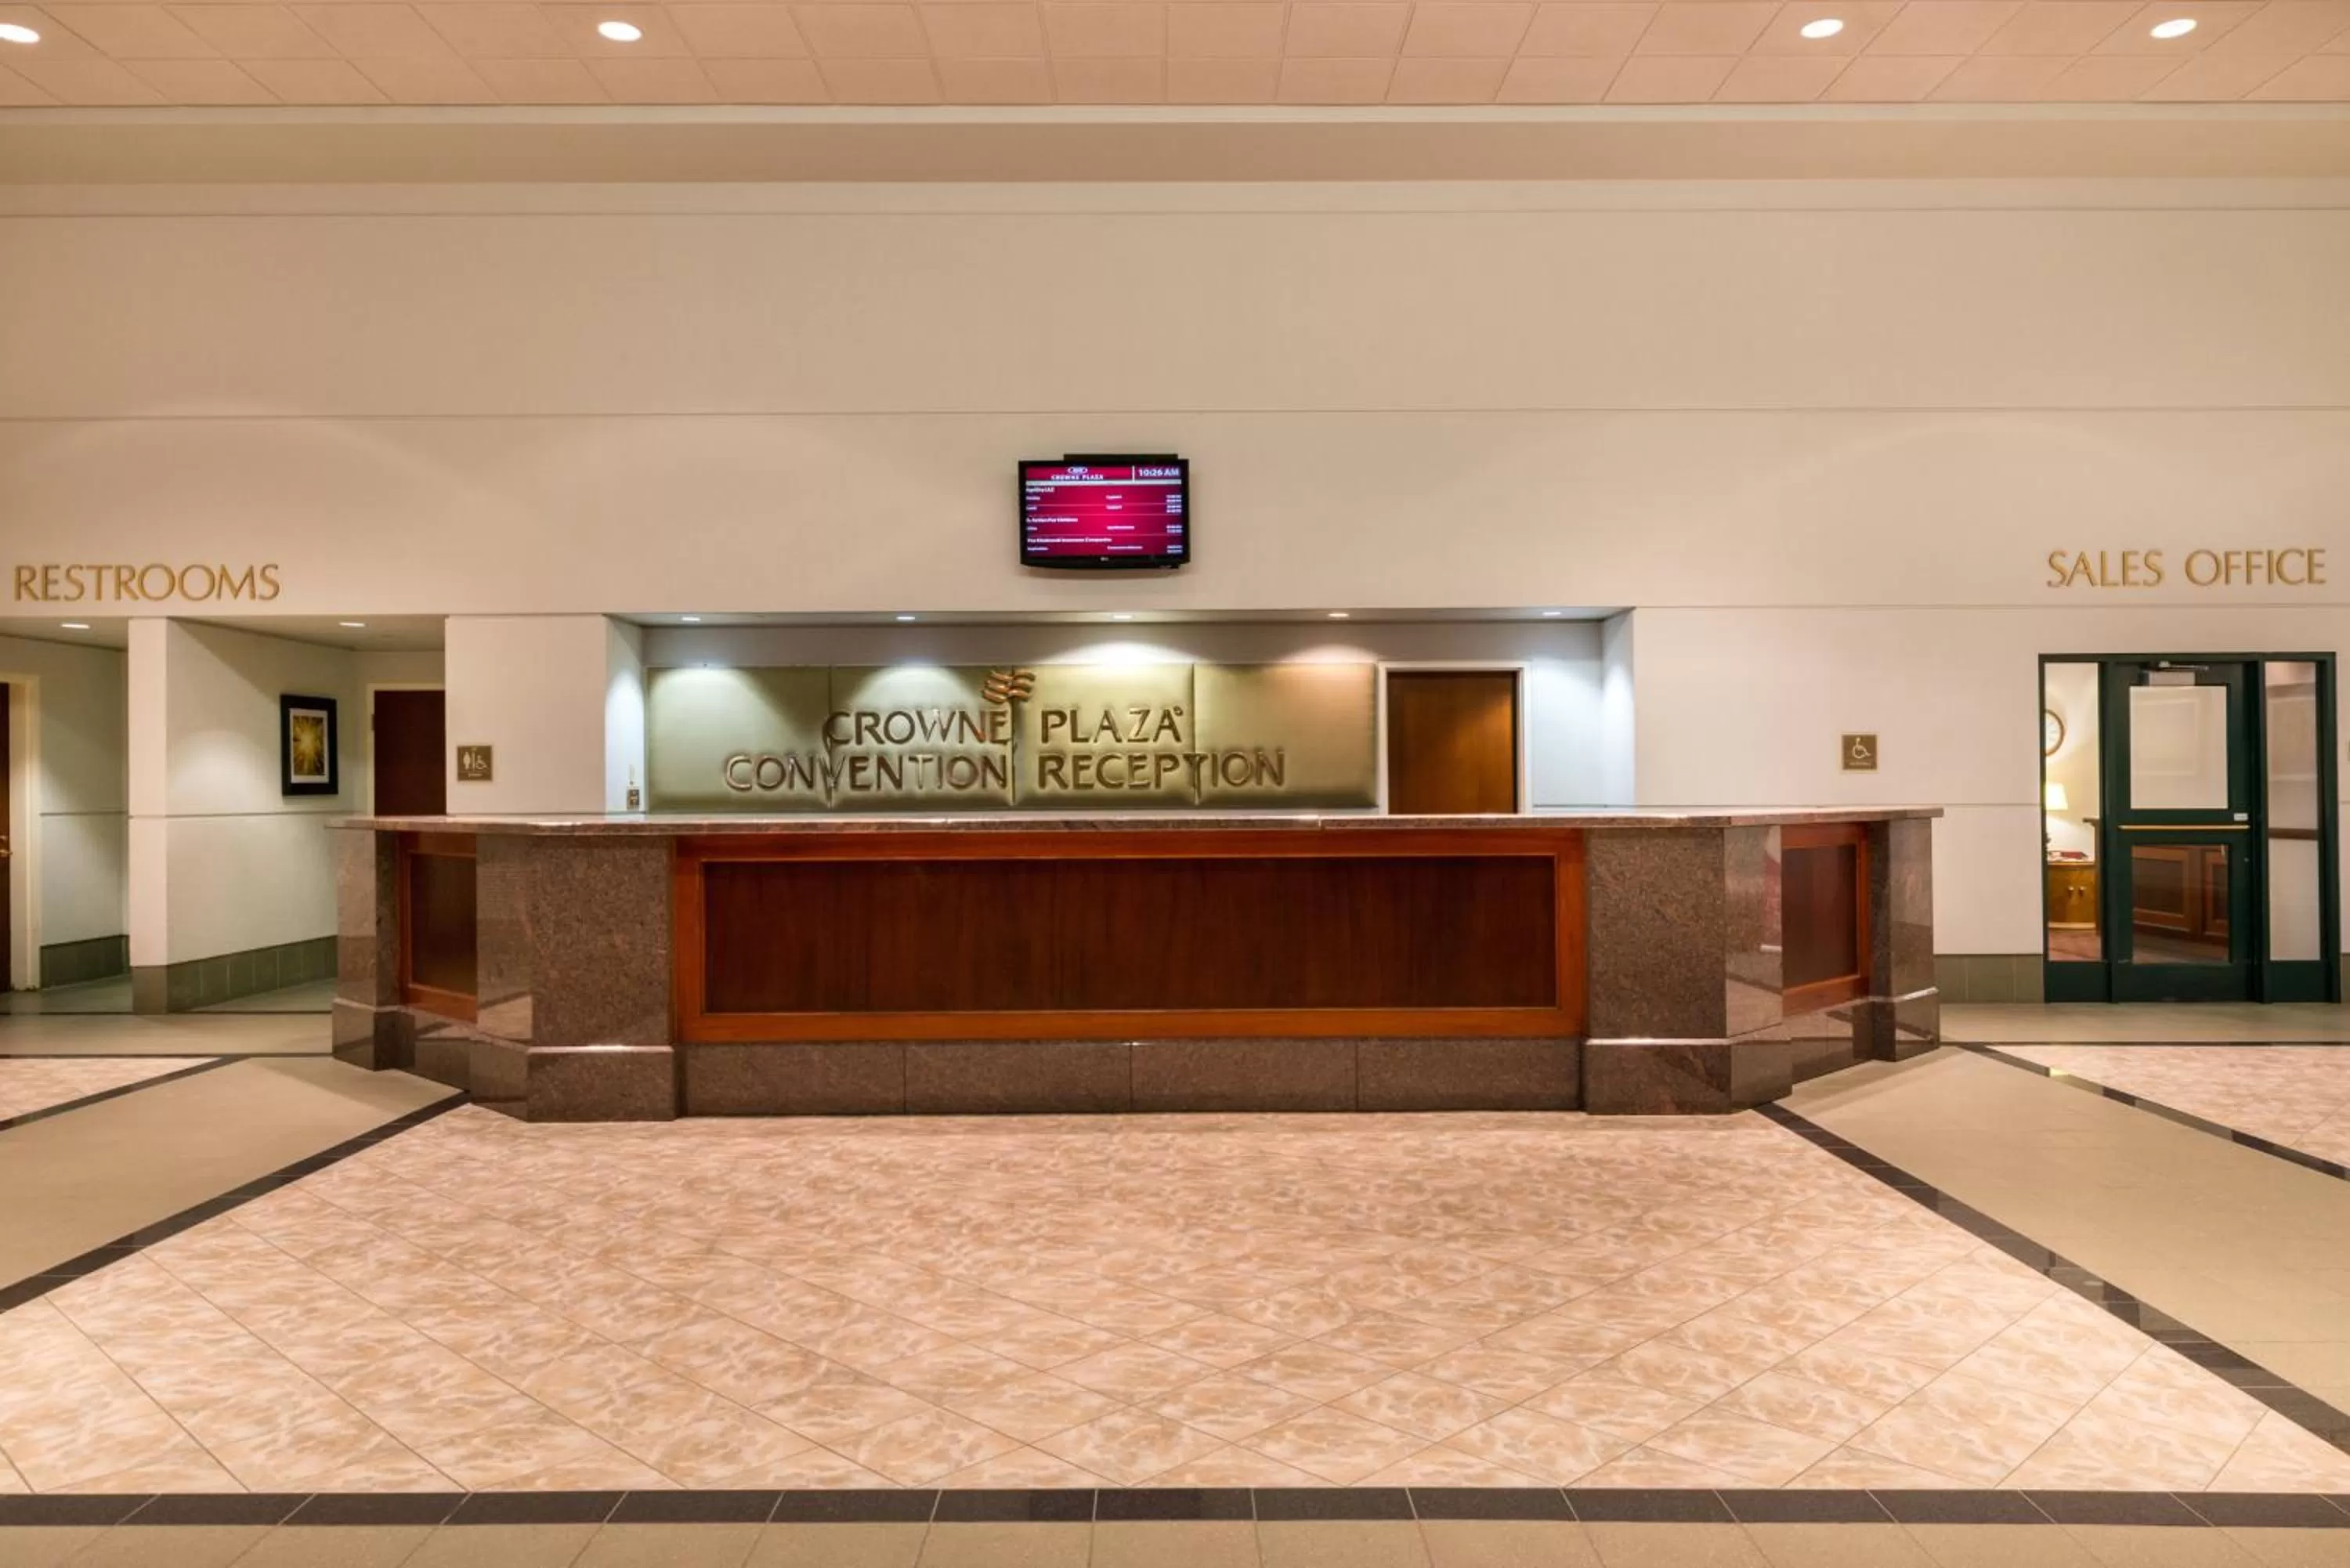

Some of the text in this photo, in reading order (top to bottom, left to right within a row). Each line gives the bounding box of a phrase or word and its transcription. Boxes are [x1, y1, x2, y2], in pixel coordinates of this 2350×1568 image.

[1164, 468, 1179, 476] AM
[13, 563, 280, 602] RESTROOMS
[2046, 548, 2327, 587] SALES OFFICE
[823, 710, 1010, 745] CROWNE
[725, 751, 1285, 791] CONVENTION RECEPTION
